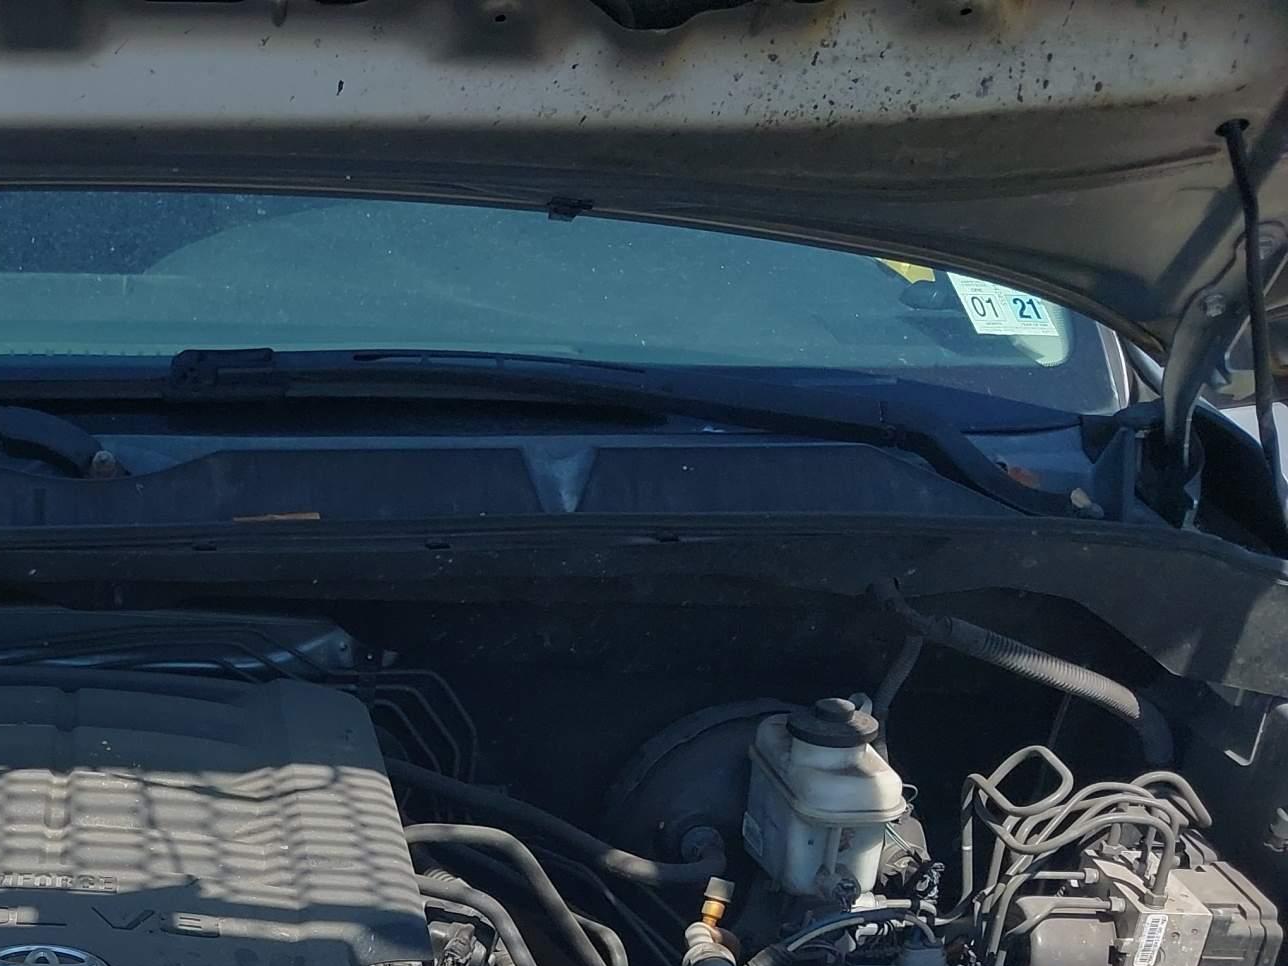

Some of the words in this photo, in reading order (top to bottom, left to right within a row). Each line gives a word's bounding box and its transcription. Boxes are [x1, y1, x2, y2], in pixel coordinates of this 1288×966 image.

[971, 296, 999, 318] 01
[1013, 297, 1041, 319] 21
[91, 907, 221, 938] V8
